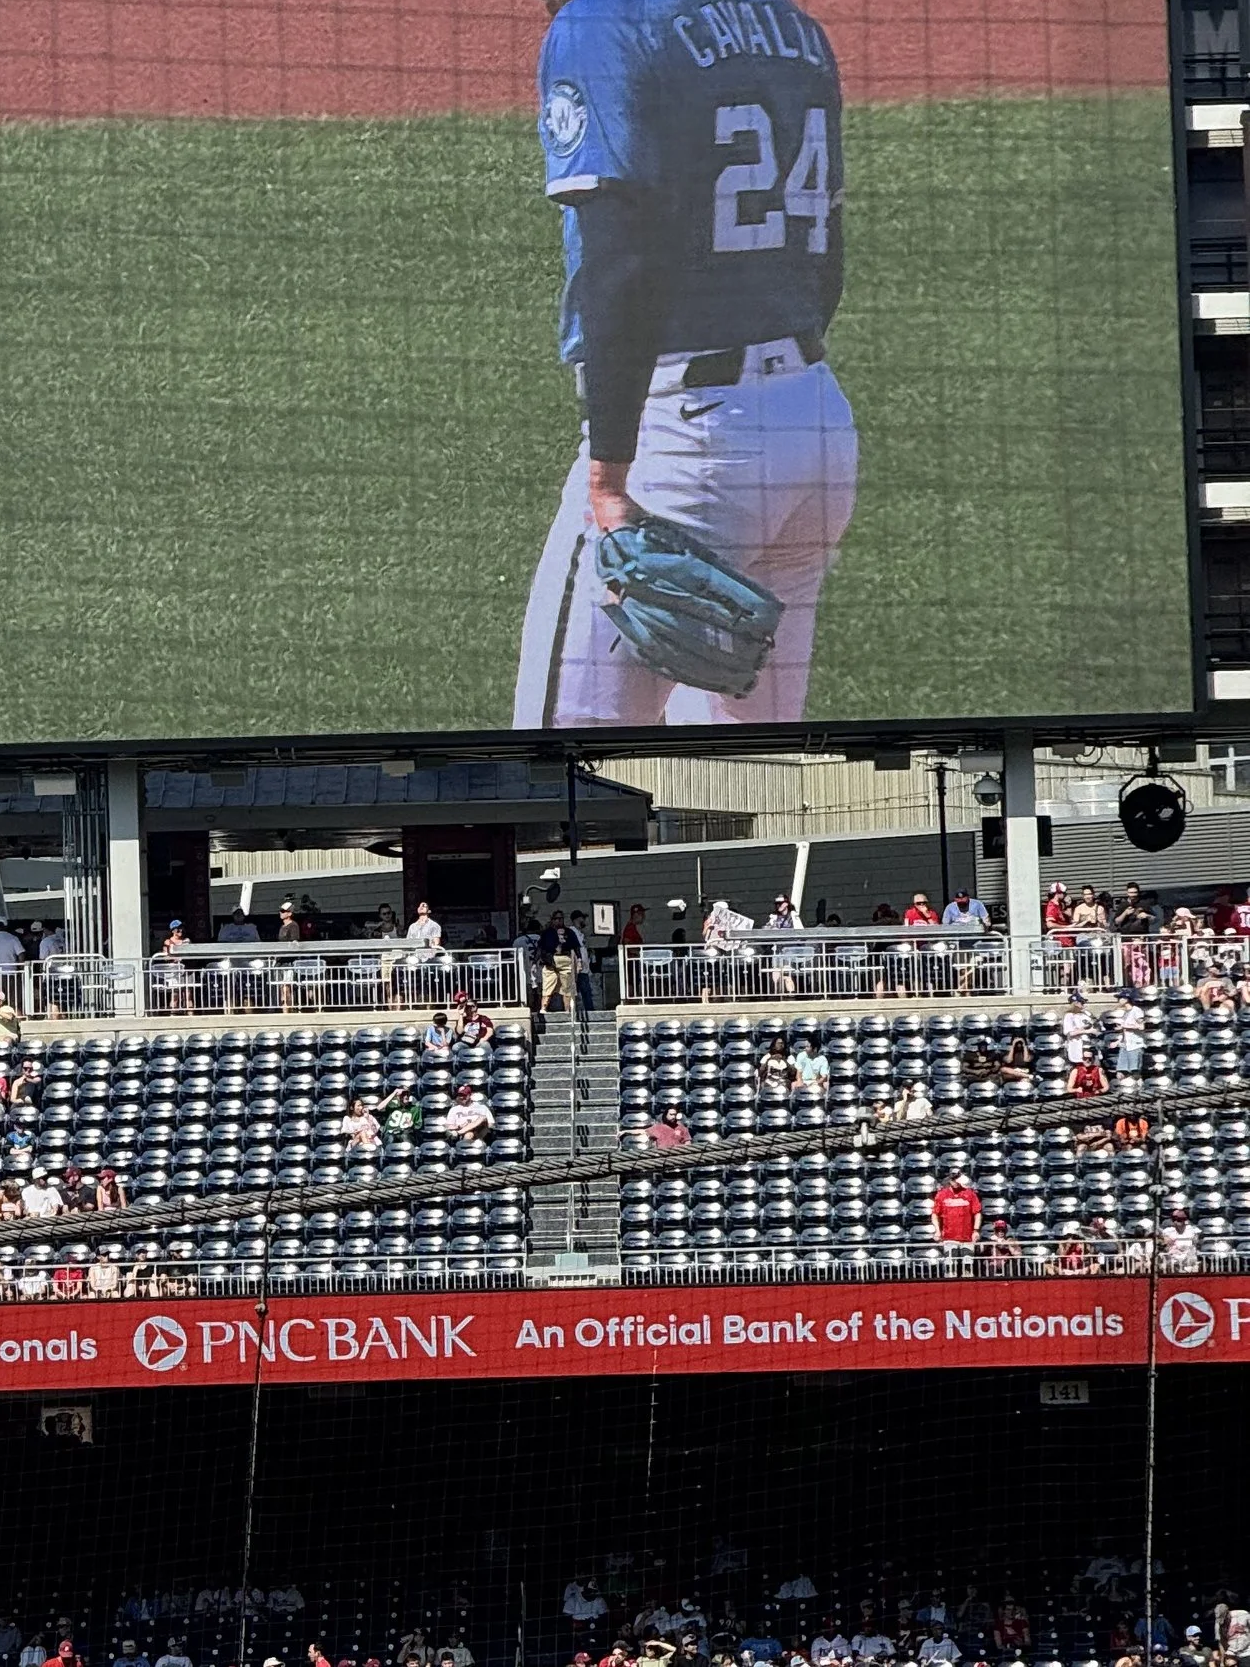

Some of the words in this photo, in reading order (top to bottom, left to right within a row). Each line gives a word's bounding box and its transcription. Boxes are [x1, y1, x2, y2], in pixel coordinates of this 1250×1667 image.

[713, 103, 831, 255] 24
[514, 1319, 565, 1348] An
[574, 1314, 711, 1348] Official
[723, 1311, 817, 1345] Bank
[826, 1310, 863, 1343] of
[873, 1309, 935, 1341] the
[945, 1305, 1124, 1339] Nationals
[1047, 1383, 1080, 1401] 141
